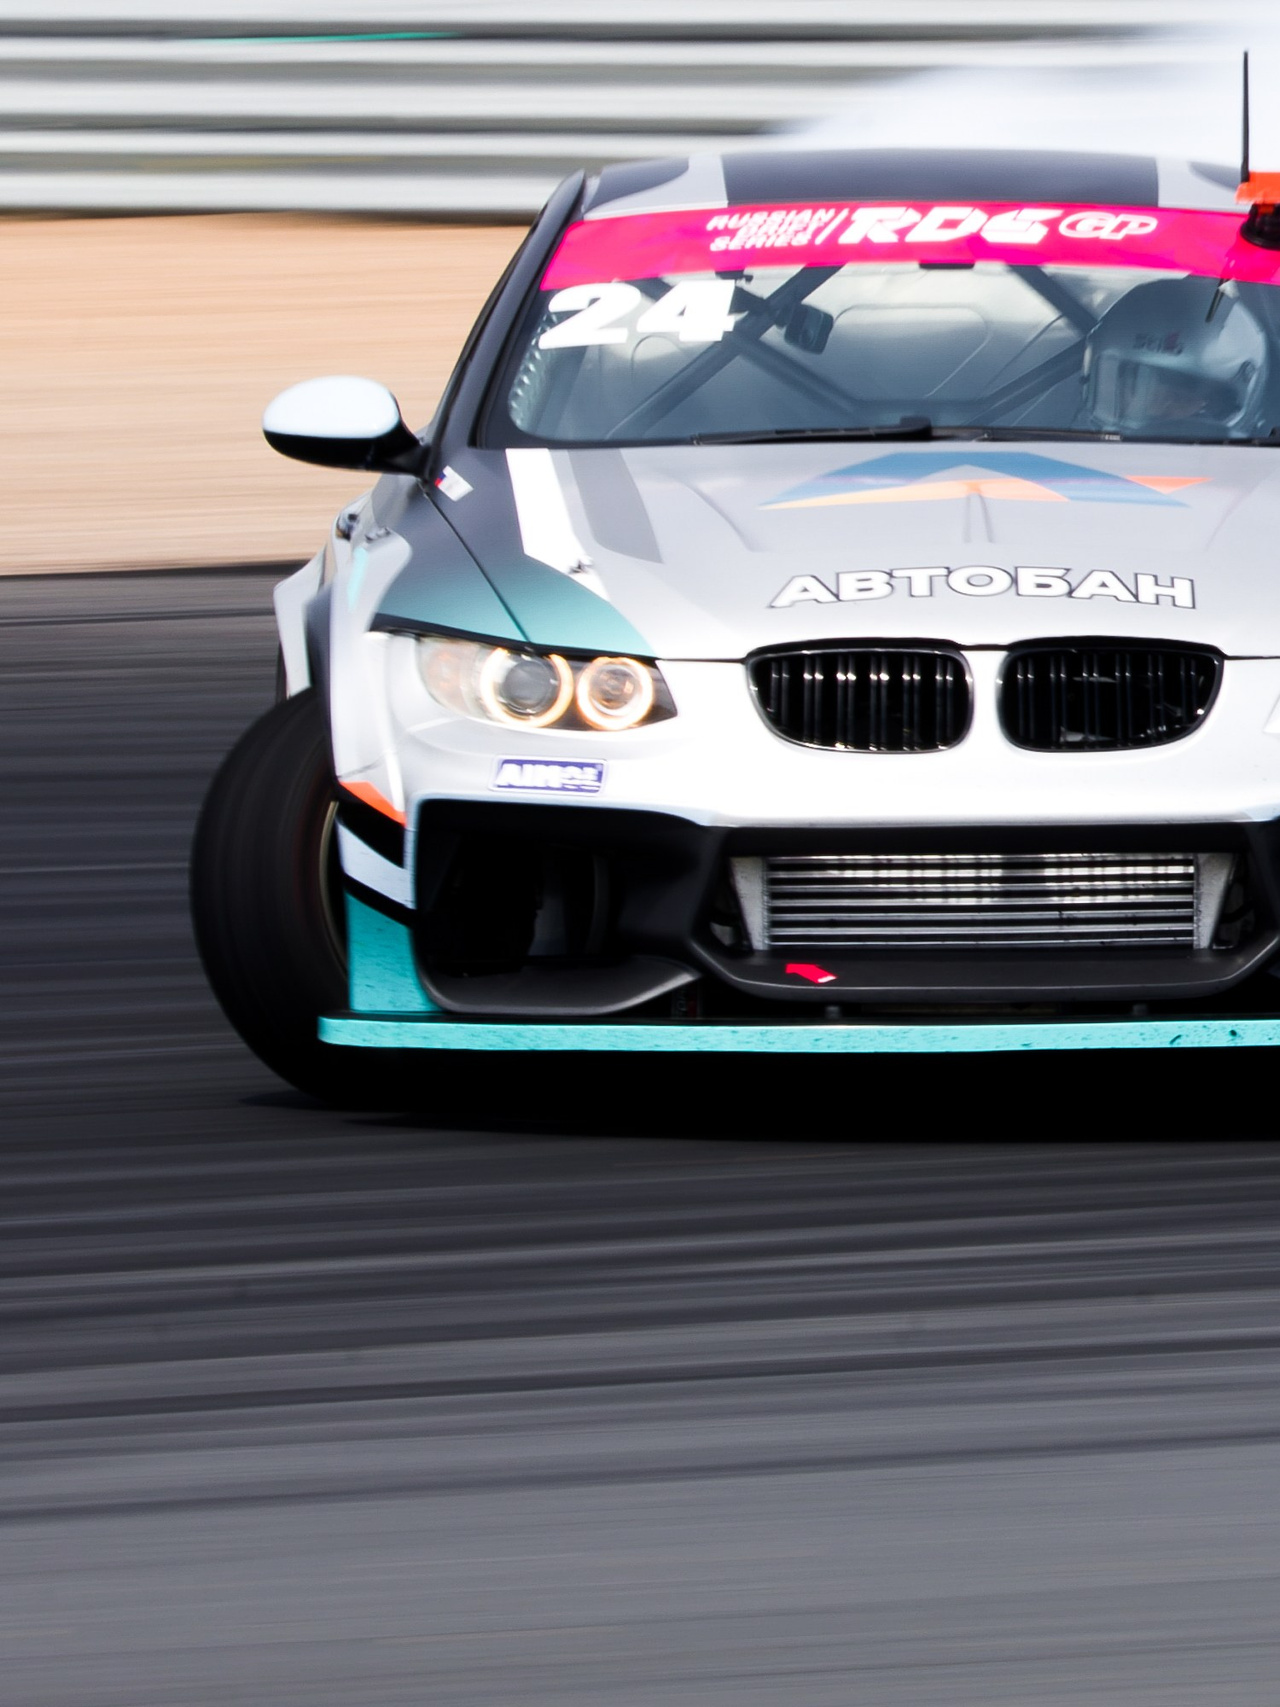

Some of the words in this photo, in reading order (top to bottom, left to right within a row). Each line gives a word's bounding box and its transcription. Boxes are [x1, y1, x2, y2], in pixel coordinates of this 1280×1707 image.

[706, 208, 836, 231] RUSSIAN
[1058, 211, 1158, 240] GP
[709, 231, 812, 251] SERIES
[538, 280, 736, 350] 24
[768, 565, 1196, 609] АВТОБАН
[495, 763, 602, 790] AIMOL
